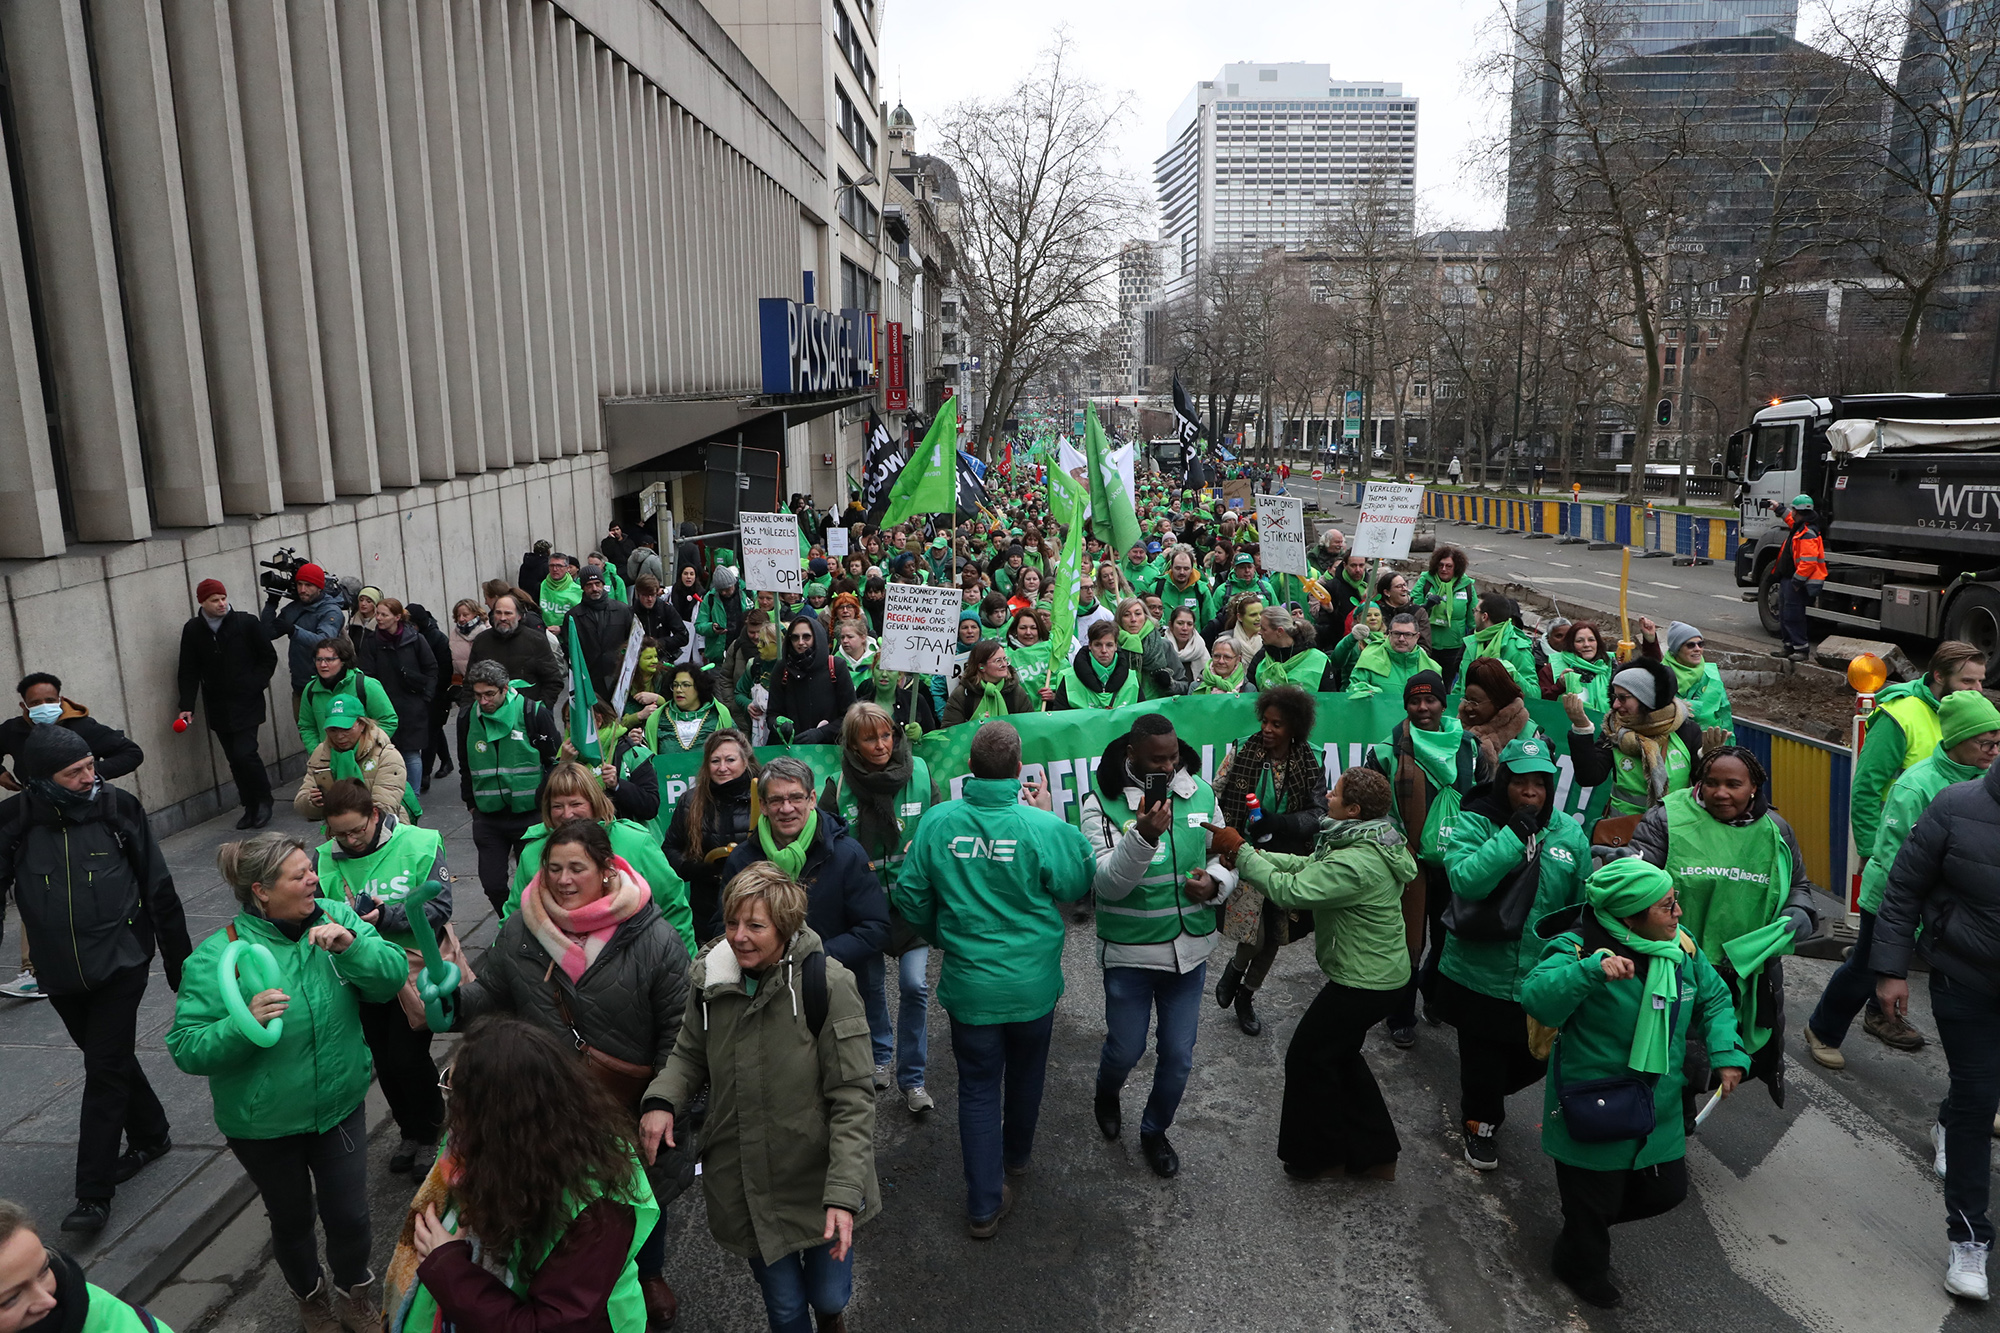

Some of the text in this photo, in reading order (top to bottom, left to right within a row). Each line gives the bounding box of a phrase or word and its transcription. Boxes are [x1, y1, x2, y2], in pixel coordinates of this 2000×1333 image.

[787, 300, 870, 394] PASSAGE 44
[1259, 498, 1293, 509] LAAT ONS
[741, 514, 772, 523] BEHANDEL
[744, 526, 756, 535] ALS
[743, 538, 762, 546] ONZE
[1391, 528, 1397, 545] !
[744, 546, 794, 556] DRAAGKRACHT
[889, 586, 956, 597] ALS DONKEY KAN
[888, 595, 959, 606] NEUKEN MET EEN
[915, 606, 932, 614] KAN
[935, 608, 946, 616] DE
[929, 617, 946, 625] ONS
[886, 622, 909, 631] GEVEN
[912, 624, 945, 633] WAARVOOR
[904, 635, 957, 655] STAAK
[948, 836, 1018, 862] CNE
[1680, 866, 1730, 877] LBC-NVK
